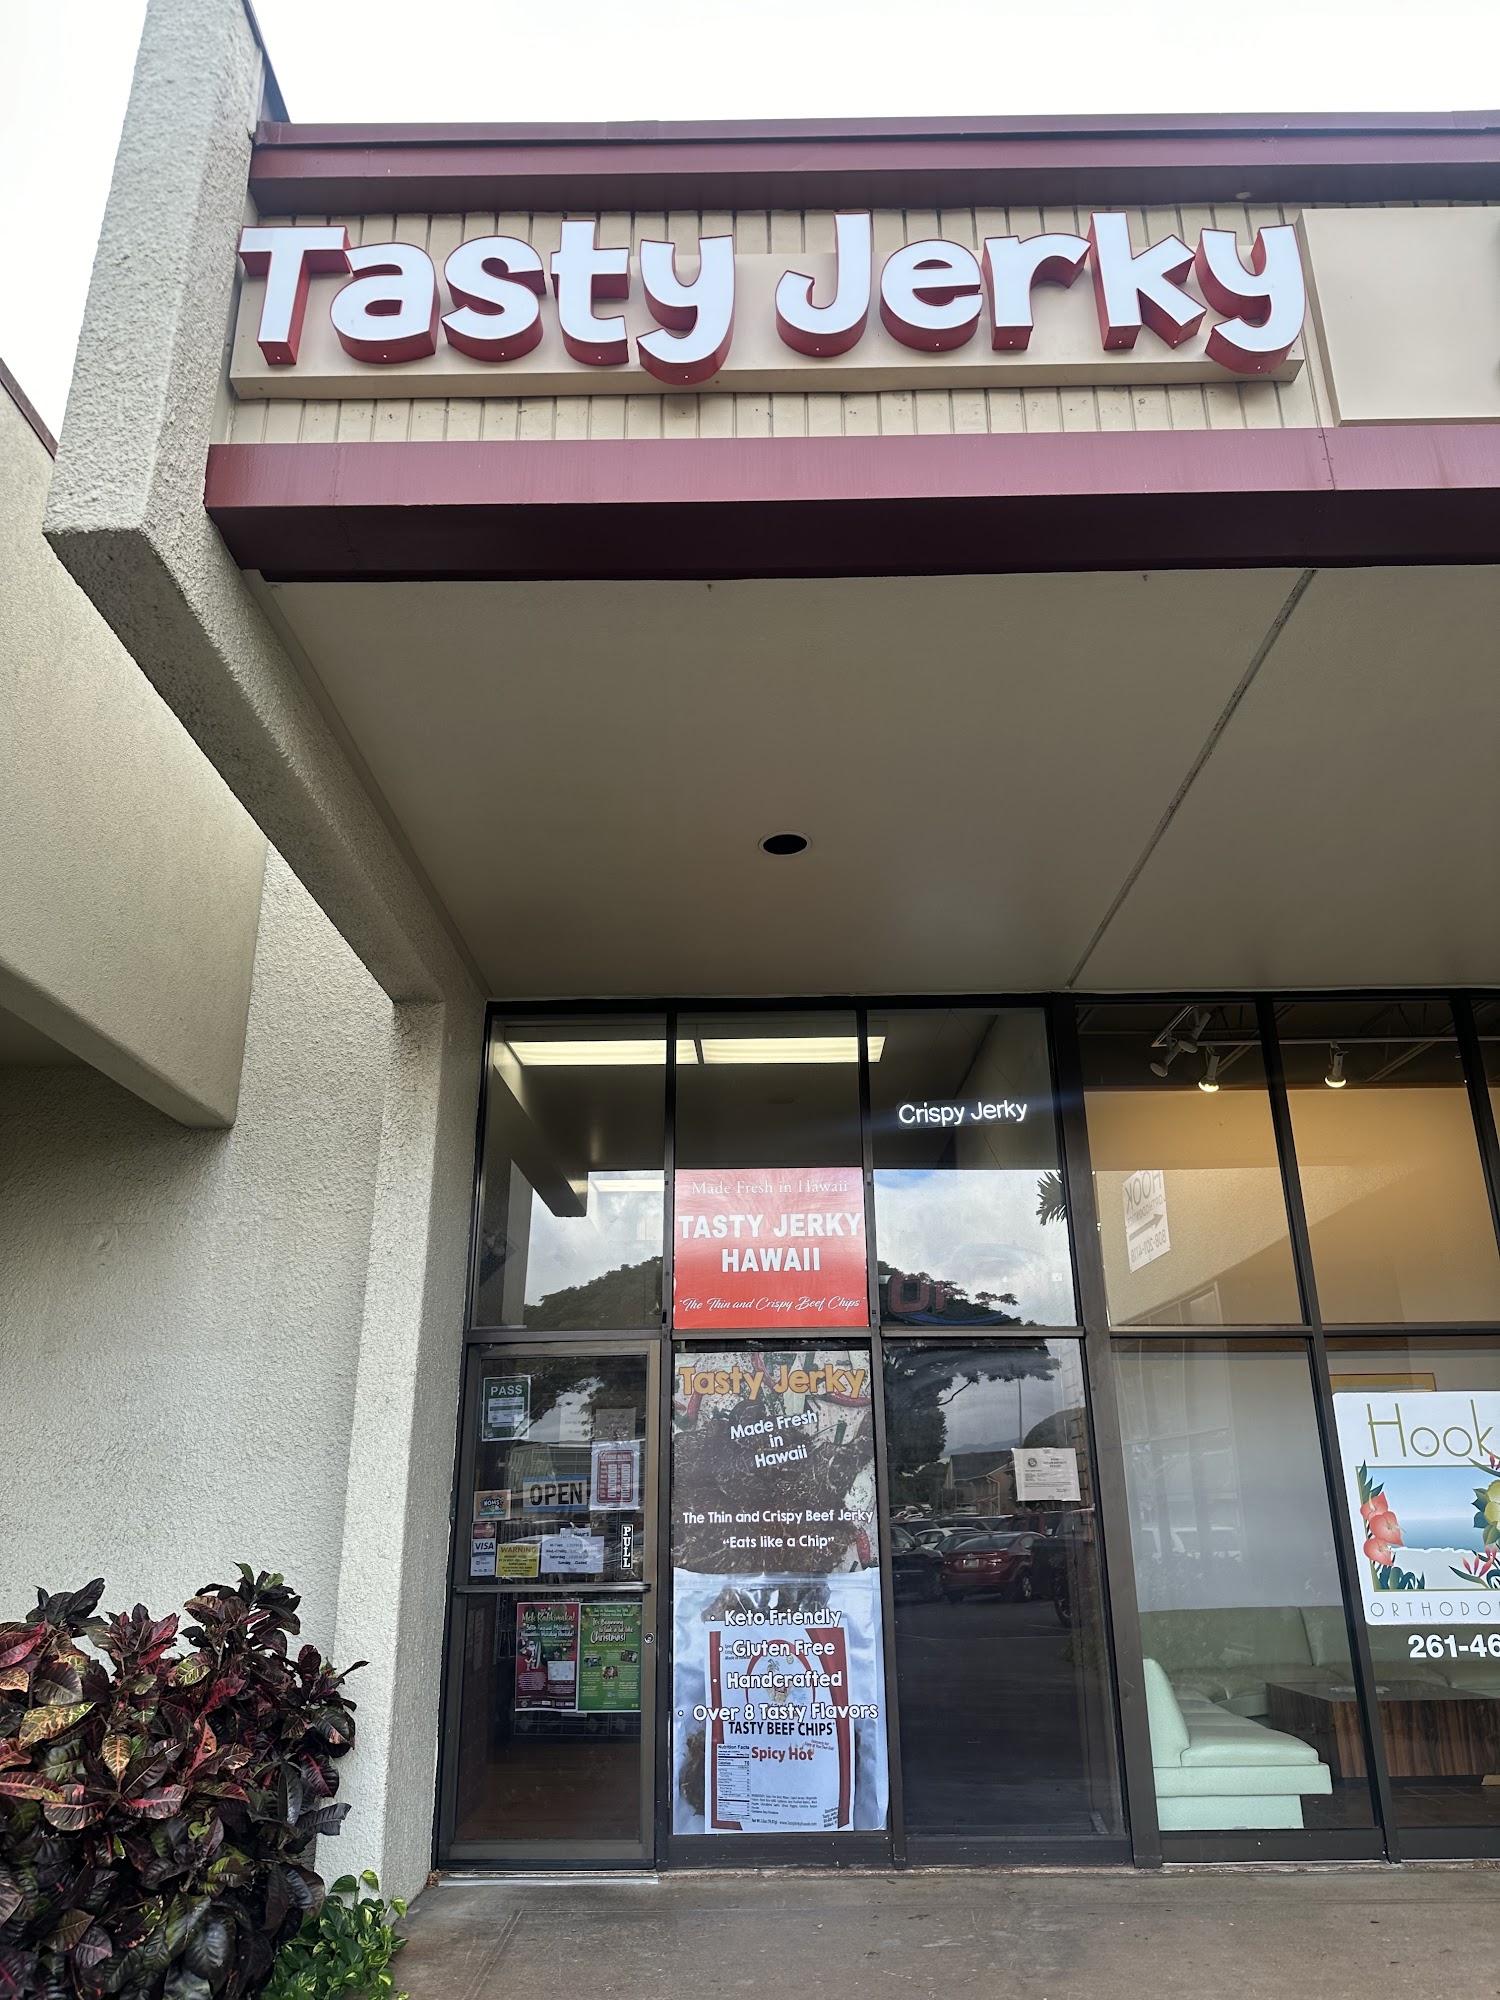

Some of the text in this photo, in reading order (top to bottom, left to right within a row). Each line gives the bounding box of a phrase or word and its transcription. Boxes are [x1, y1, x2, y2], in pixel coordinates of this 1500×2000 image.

[240, 210, 1305, 384] Tasty Jerky
[899, 1099, 1028, 1126] Crispy Jerky
[691, 1179, 848, 1194] Made Fresh in Hawaii
[677, 1212, 862, 1239] TASTY JERKY
[721, 1247, 821, 1273] HAWAII
[706, 1298, 731, 1312] Thin
[733, 1298, 753, 1309] and
[755, 1297, 793, 1312] Crispy
[795, 1297, 824, 1312] Beef
[490, 1384, 523, 1396] PASS
[679, 1364, 865, 1400] Tasty Jerky
[730, 1410, 818, 1440] Made Fresh
[1366, 1399, 1500, 1459] Hook
[769, 1434, 784, 1448] in
[754, 1445, 808, 1468] Hawaii
[530, 1482, 583, 1507] OPEN
[683, 1509, 874, 1525] The Thin and Crispy Beef Jerky
[475, 1542, 494, 1550] VISA
[622, 1526, 632, 1568] PULL
[760, 1535, 783, 1547] like
[787, 1538, 796, 1547] a
[725, 1609, 842, 1628] Keto Friendly
[1370, 1601, 1500, 1617] ORTHODO
[732, 1640, 791, 1657] Gluten
[795, 1639, 836, 1656] Free
[1407, 1632, 1500, 1658] 261-46
[727, 1671, 843, 1690] Handcrafted
[693, 1702, 879, 1723] Over 8 Tasty Flavors
[728, 1721, 833, 1736] TASTY BEEF CHIPS
[751, 1746, 785, 1763] Spicy
[789, 1745, 814, 1760] Hot
